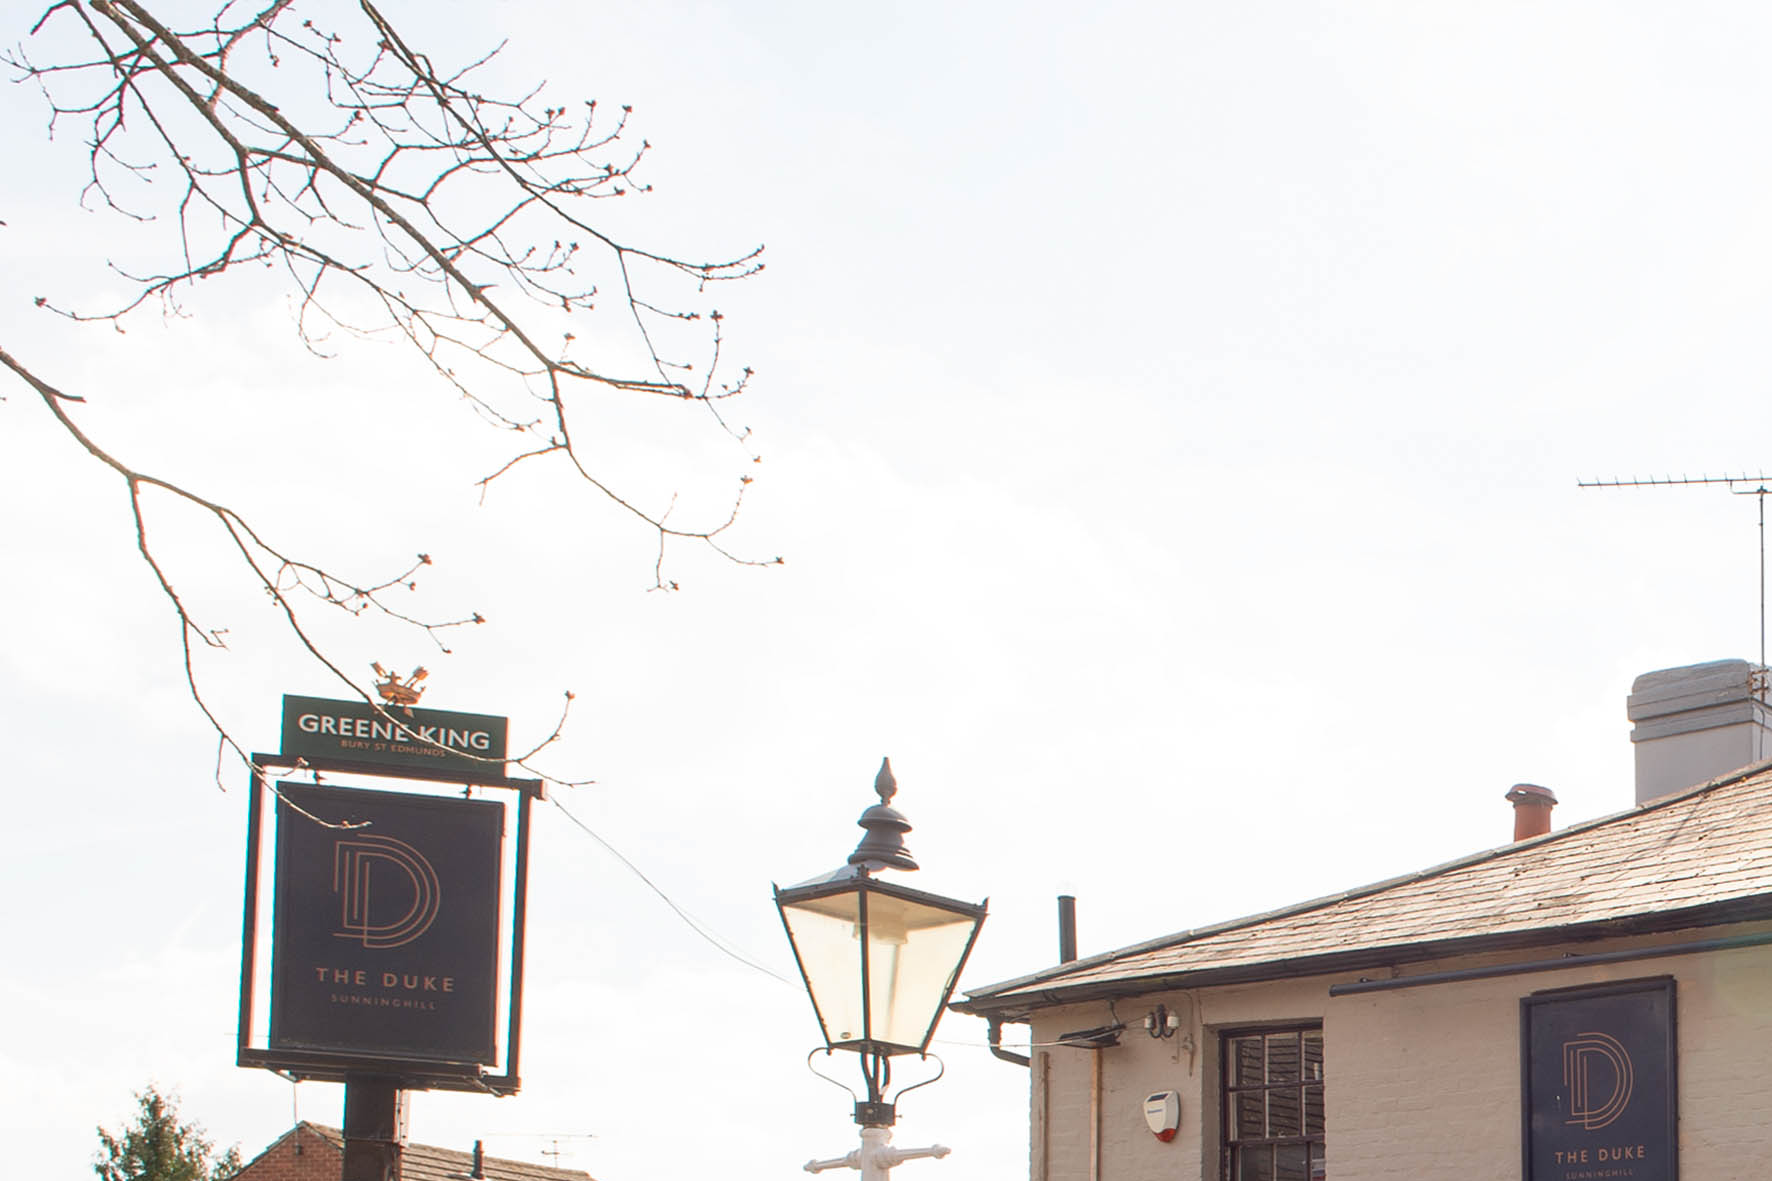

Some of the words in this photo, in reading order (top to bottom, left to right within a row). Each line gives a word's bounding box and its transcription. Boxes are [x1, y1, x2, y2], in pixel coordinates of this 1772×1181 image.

[298, 714, 409, 742] GREENE
[418, 725, 490, 750] KING
[340, 739, 370, 750] BURY
[374, 742, 387, 752] ST
[391, 743, 446, 758] EDMUNDS
[316, 967, 367, 985] THE
[383, 972, 455, 992] DUKE
[1554, 1149, 1589, 1165] THE
[1598, 1145, 1646, 1161] DUKE
